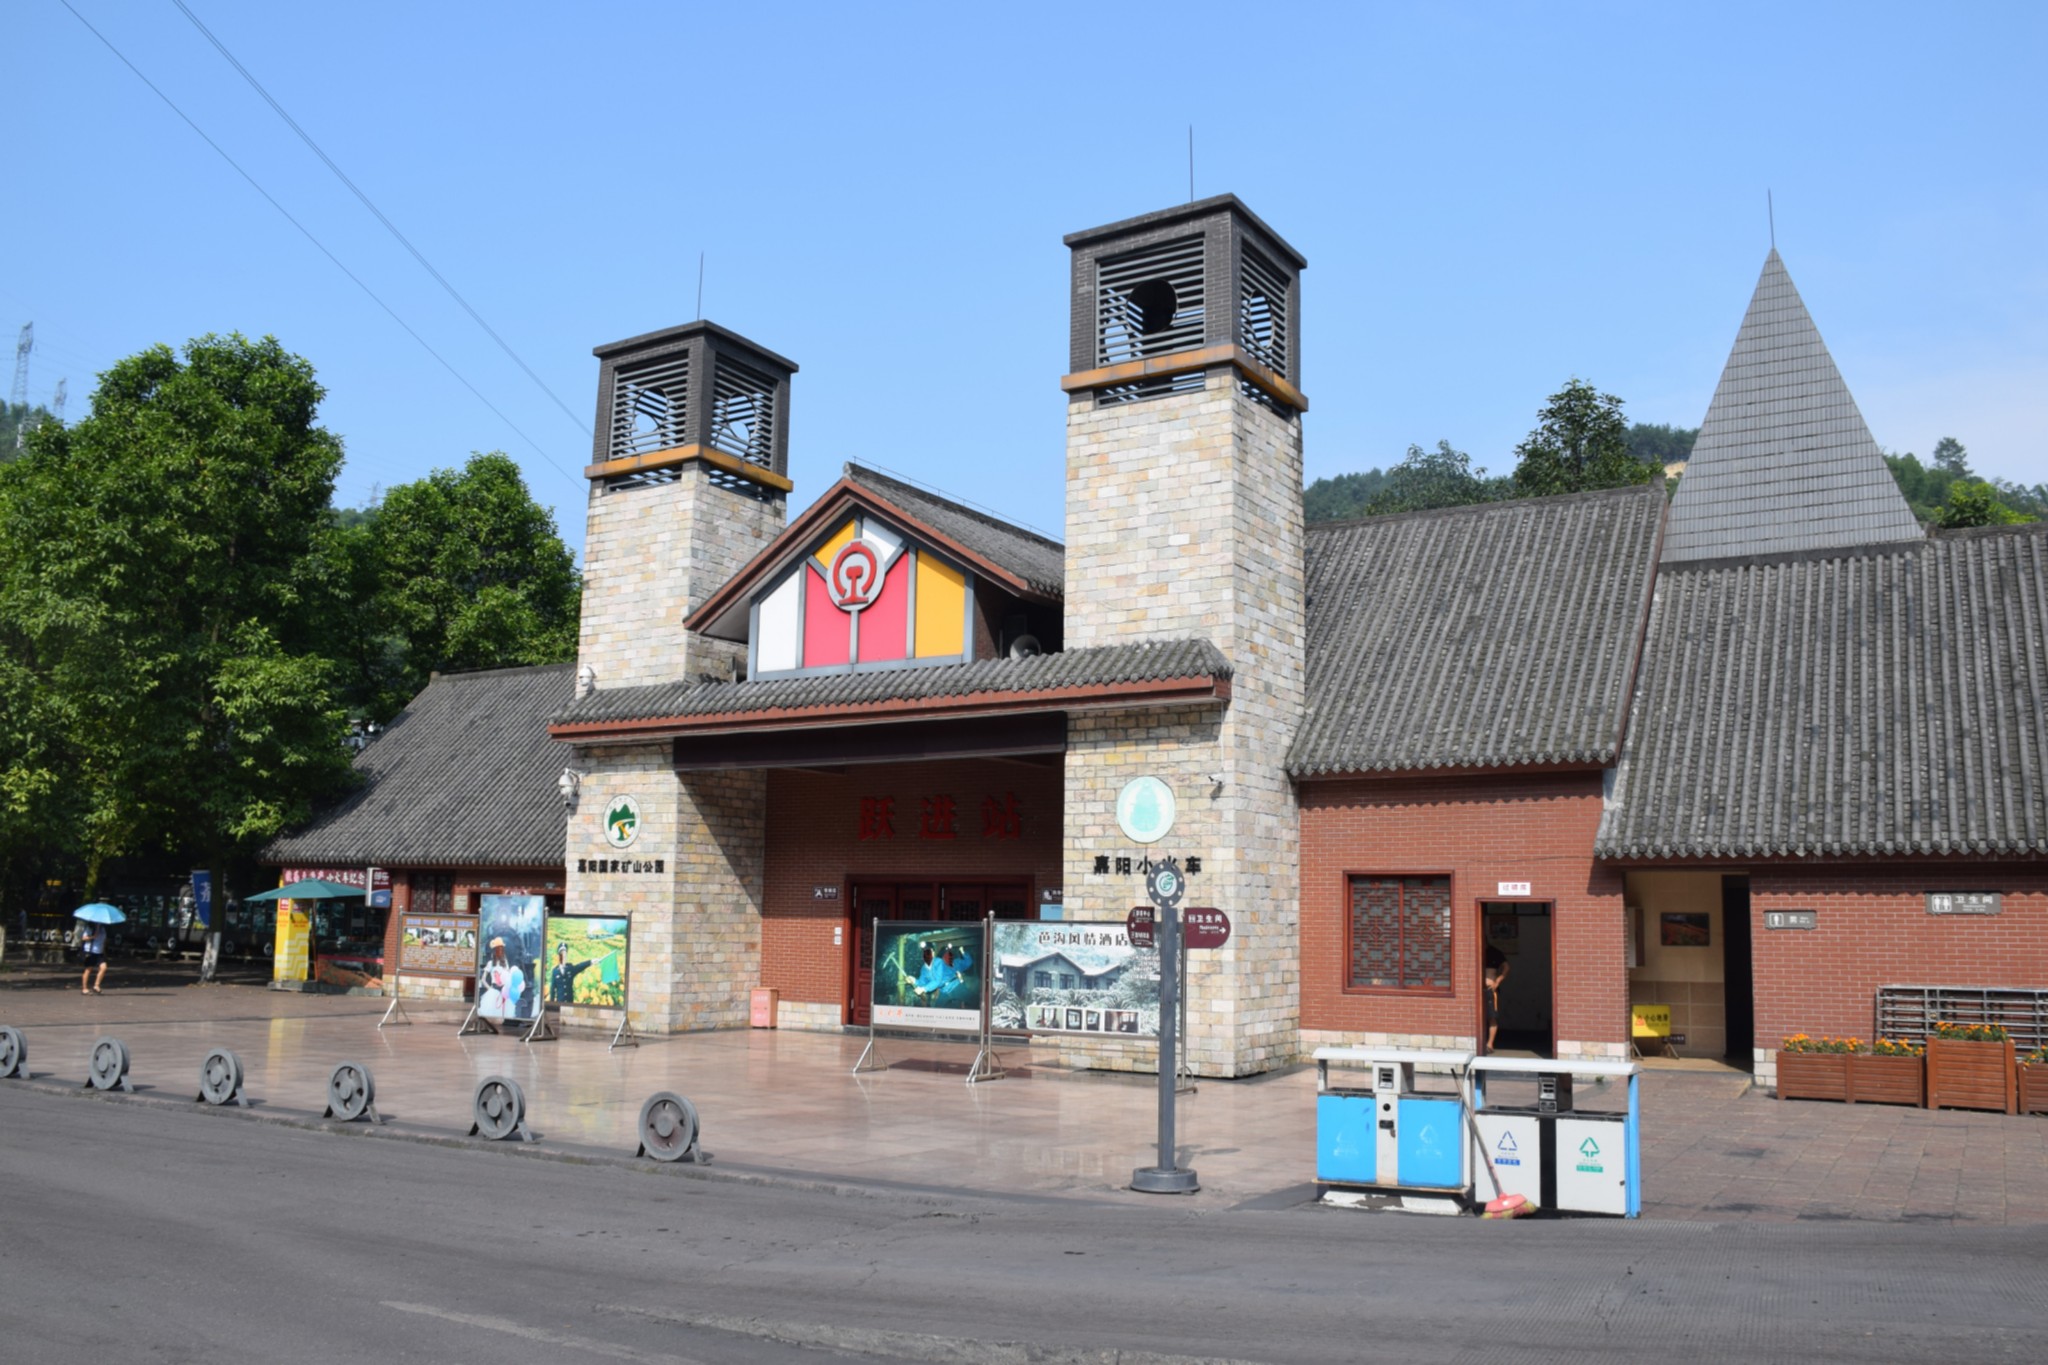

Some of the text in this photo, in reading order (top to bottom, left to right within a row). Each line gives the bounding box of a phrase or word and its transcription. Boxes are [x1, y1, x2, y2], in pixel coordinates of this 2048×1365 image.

[857, 791, 1022, 841] 跃进站
[578, 859, 664, 874] 嘉阳国家矿山公园
[1954, 895, 1993, 905] 卫生间
[1196, 914, 1223, 923] 卫生间
[1039, 931, 1128, 947] 芭沟风情酒店
